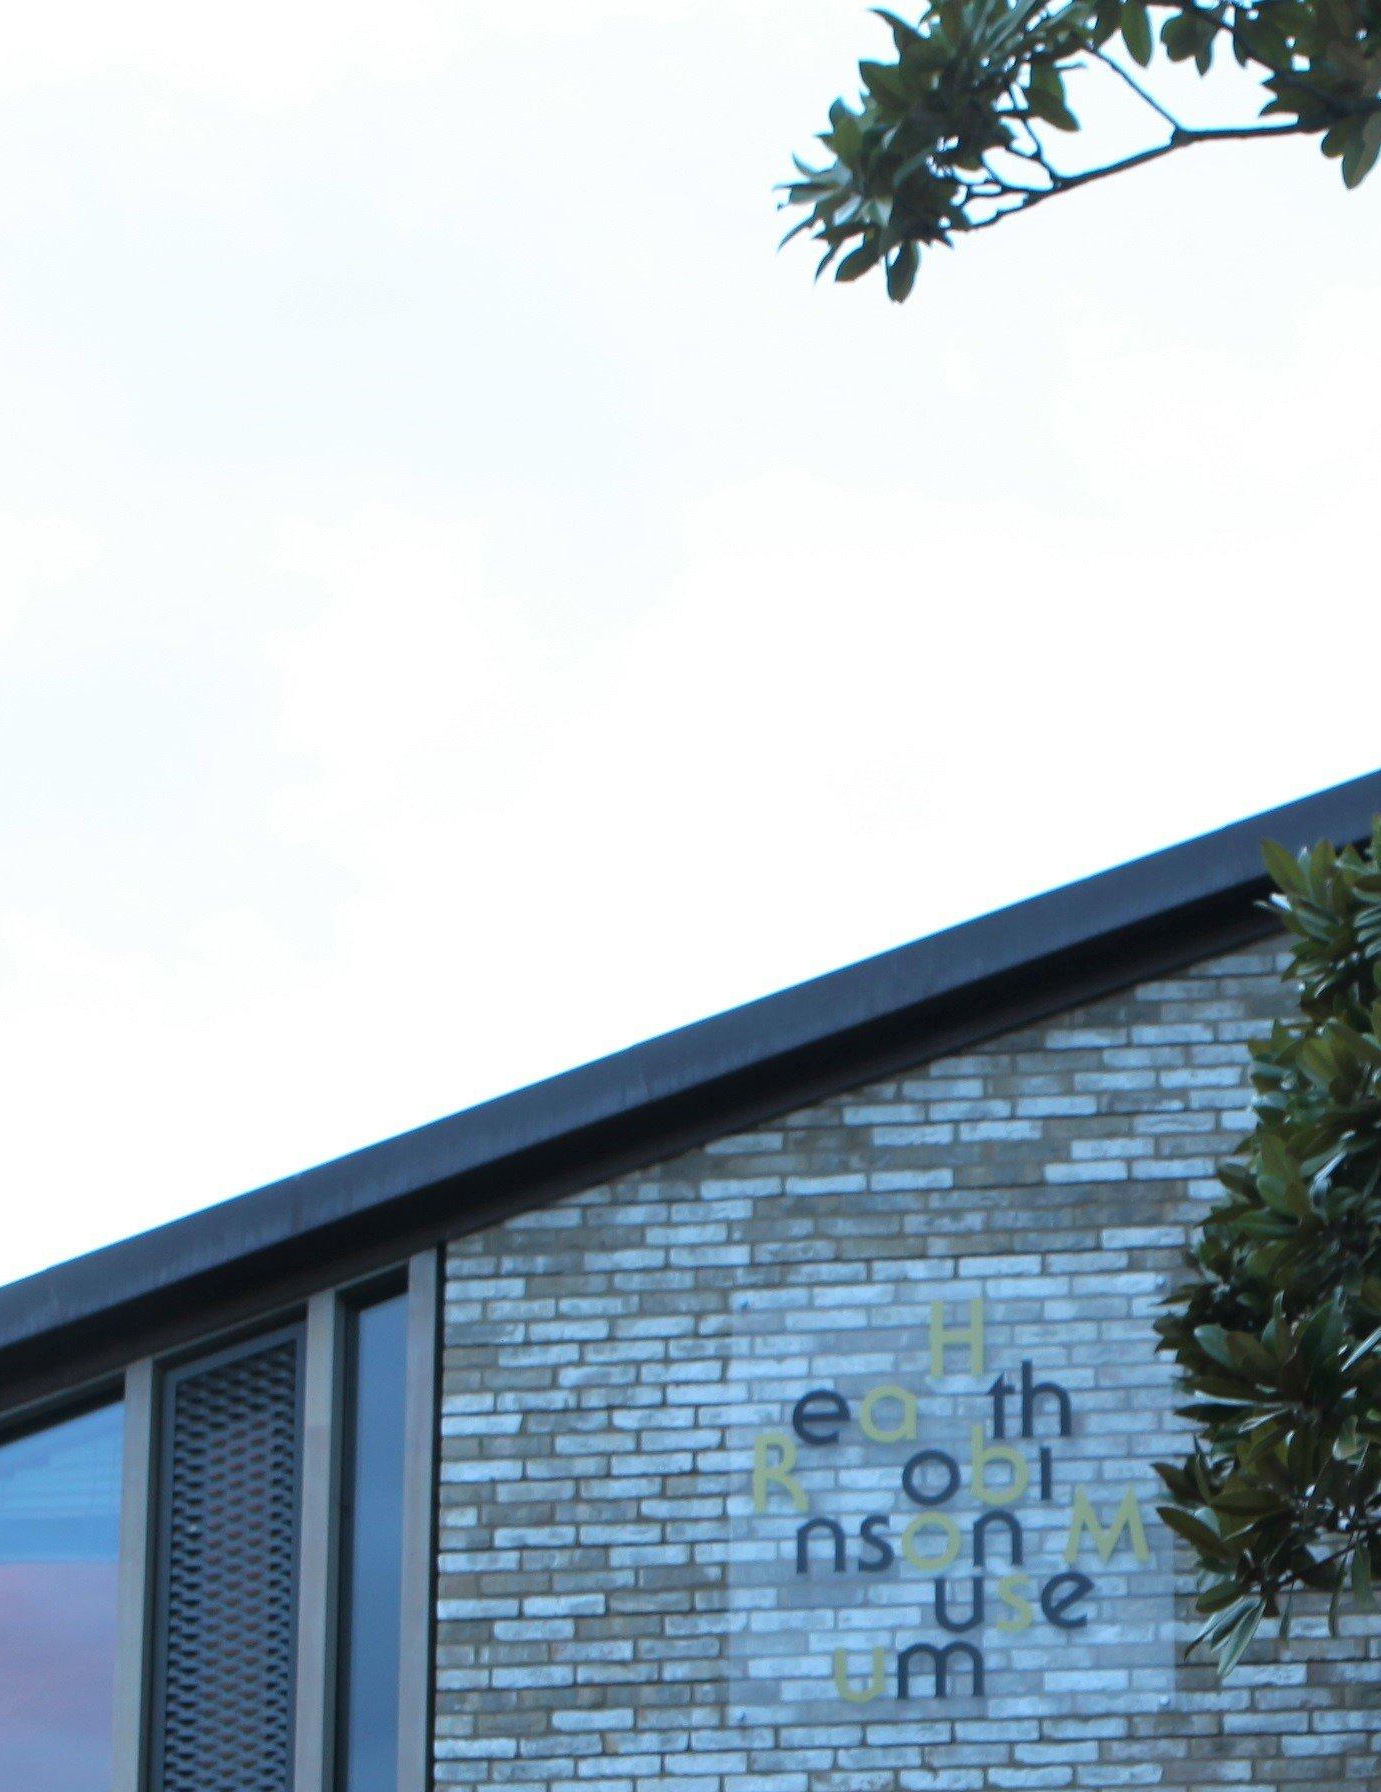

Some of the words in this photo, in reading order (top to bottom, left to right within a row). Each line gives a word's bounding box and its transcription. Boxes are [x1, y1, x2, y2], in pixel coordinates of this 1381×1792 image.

[929, 1299, 984, 1379] H
[935, 1571, 1094, 1633] use
[833, 1642, 984, 1703] um
